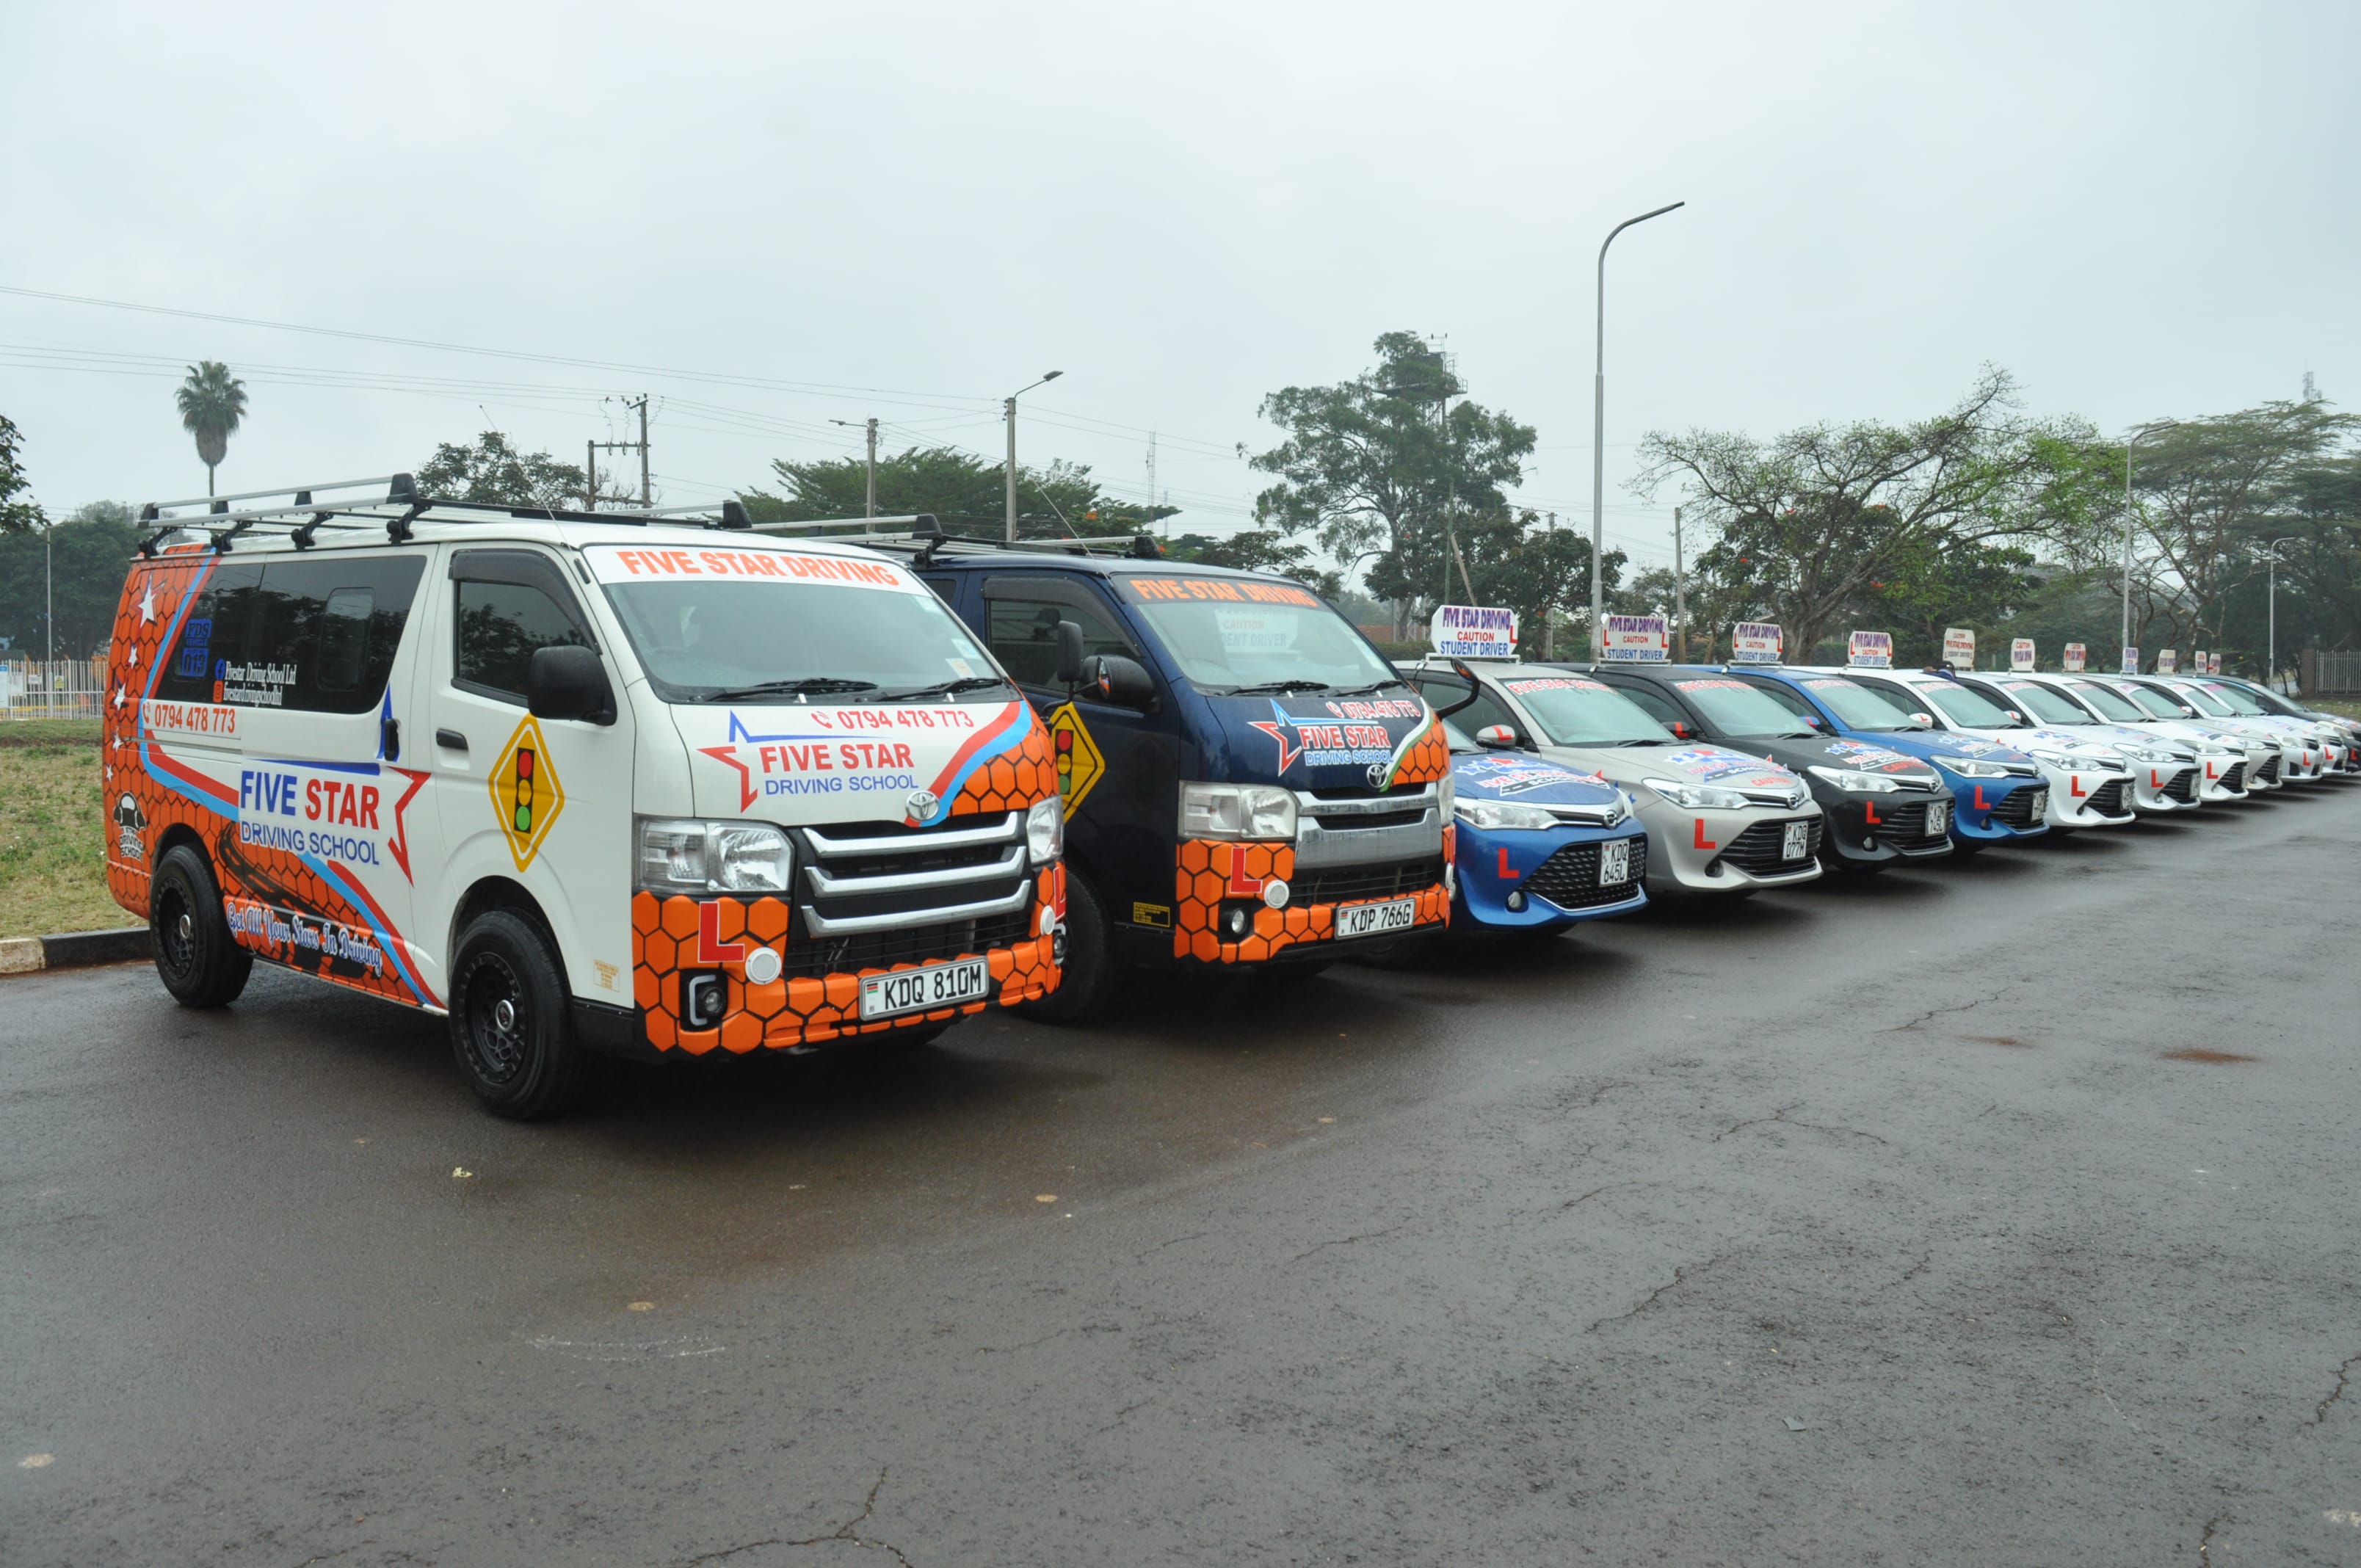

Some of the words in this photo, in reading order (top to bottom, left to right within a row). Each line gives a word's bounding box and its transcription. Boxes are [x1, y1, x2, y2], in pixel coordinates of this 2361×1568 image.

[616, 551, 703, 575] FIVE
[698, 552, 788, 576] STAR
[778, 556, 900, 587] DRIVING
[1130, 580, 1191, 599] FIVE
[1183, 580, 1245, 600] STAR
[1236, 581, 1318, 608] DRIVING
[1443, 607, 1460, 628] FIVE
[1462, 608, 1479, 628] STAR
[1481, 609, 1511, 630] DRIVING
[1609, 617, 1622, 631] FIVE
[1623, 617, 1637, 632] STAR
[1638, 618, 1664, 634] DRIVING
[188, 623, 208, 636] FDS
[1457, 631, 1494, 642] CAUTION
[1509, 625, 1518, 644] L
[1603, 629, 1611, 646] L
[1661, 632, 1668, 648] L
[1440, 641, 1478, 655] STUDENT
[1480, 642, 1508, 656] DRIVER
[1607, 649, 1637, 658] STUDENT
[1639, 650, 1663, 660] DRIVER
[266, 663, 286, 683] School
[155, 705, 183, 729] 0794
[186, 707, 208, 731] 478
[213, 708, 236, 733] 773
[837, 710, 893, 729] 0794
[897, 710, 935, 727] 478
[935, 710, 974, 727] 773
[1341, 702, 1377, 719] 0794
[1373, 701, 1399, 719] 478
[1395, 700, 1421, 717] 773
[1297, 726, 1345, 749] FIVE
[1344, 726, 1392, 748] STAR
[759, 744, 833, 773] FIVE
[839, 743, 915, 769] STAR
[1305, 751, 1352, 766] DRIVING
[1353, 749, 1393, 764] SCHOOL
[2303, 752, 2310, 766] L
[2324, 747, 2334, 760] L
[2151, 769, 2164, 788] L
[2207, 762, 2219, 779] L
[765, 777, 843, 796] DRIVING
[849, 774, 919, 791] SCHOOL
[2071, 775, 2086, 796] L
[241, 770, 297, 816] FIVE
[305, 778, 380, 830] STAR
[1975, 786, 1990, 810] L
[1866, 801, 1881, 824] L
[242, 821, 305, 852] DRIVING
[309, 832, 380, 865] SCHOOL
[1694, 819, 1716, 849] L
[1498, 849, 1519, 878] L
[1611, 843, 1628, 863] KDQ
[1230, 847, 1262, 893] L
[1604, 863, 1625, 882] 645L
[1351, 909, 1376, 933] KDP
[1381, 904, 1411, 928] 766G
[227, 901, 245, 938] Get
[246, 905, 262, 936] All
[264, 908, 291, 947] Your
[291, 915, 319, 950] Stars
[323, 922, 338, 955] In
[338, 927, 382, 977] Driving
[699, 902, 744, 962] L
[885, 975, 924, 1010] KDQ
[934, 964, 981, 999] 810M
